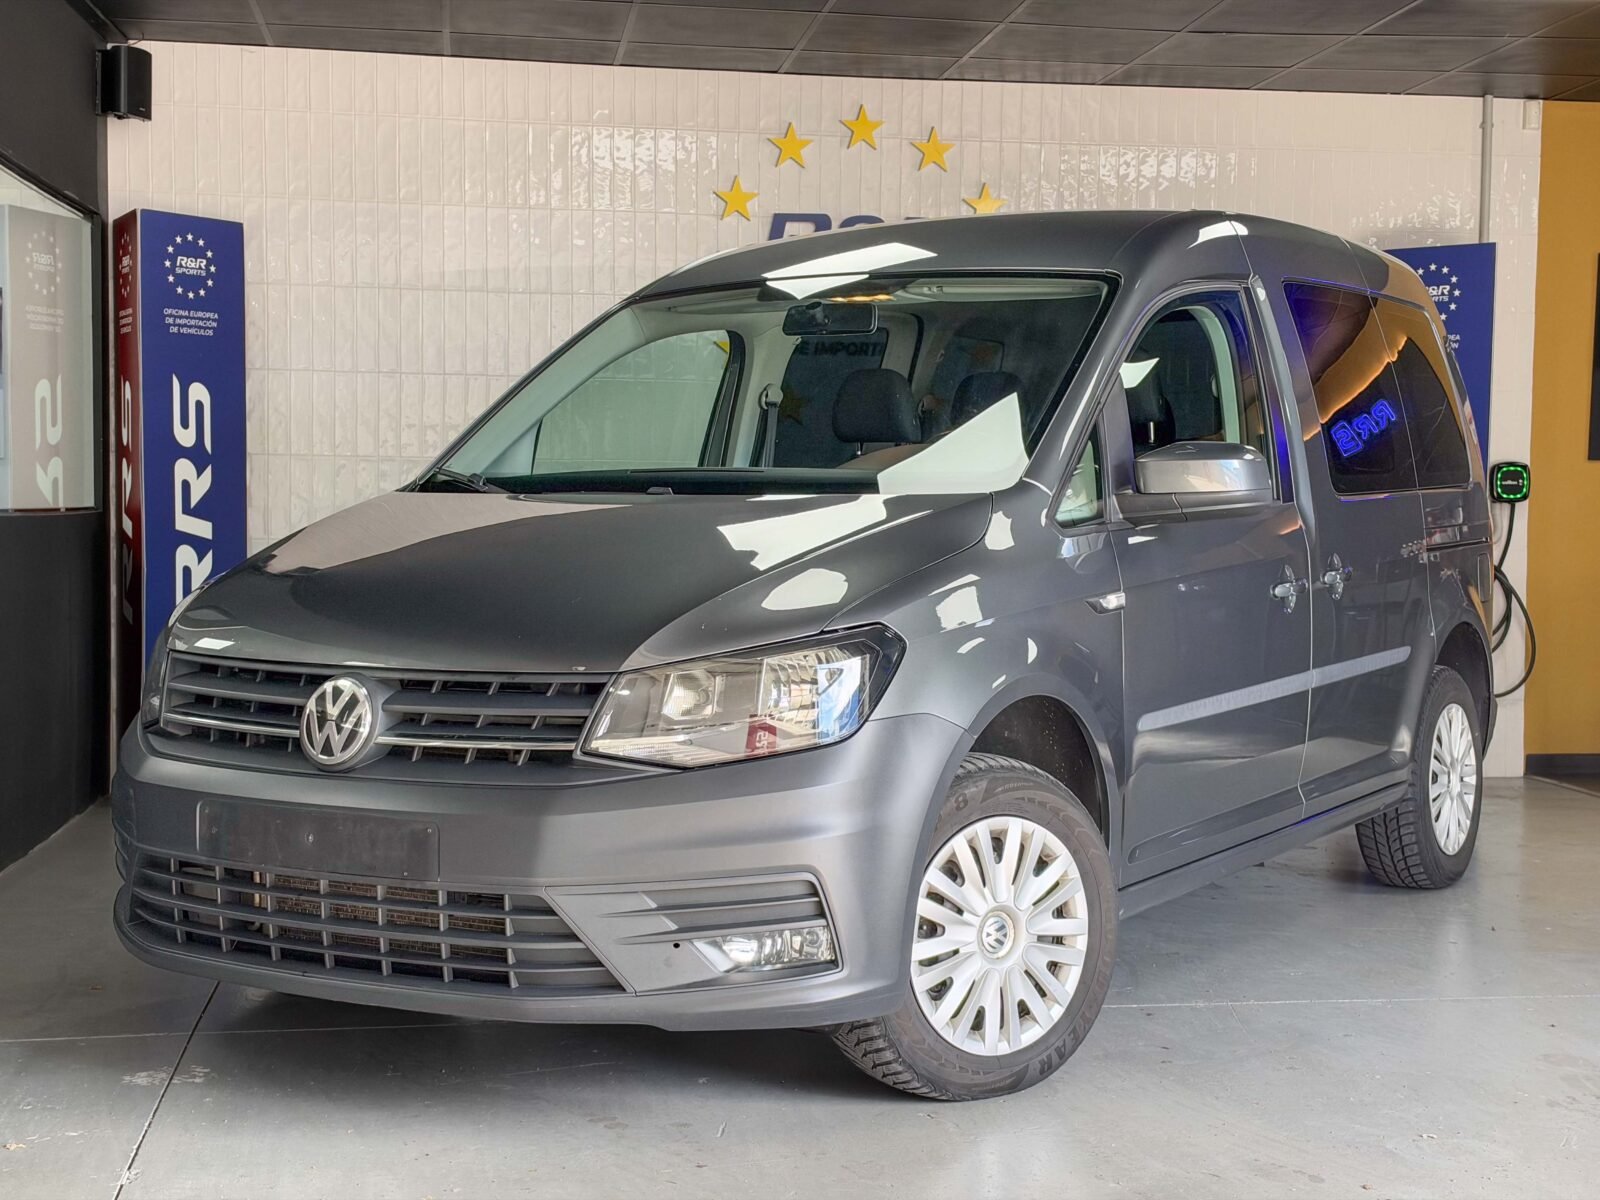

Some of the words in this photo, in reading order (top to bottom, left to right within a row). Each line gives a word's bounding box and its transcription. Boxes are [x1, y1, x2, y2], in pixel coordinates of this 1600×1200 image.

[176, 256, 207, 269] R&R
[175, 267, 207, 276] SPORTS
[1425, 285, 1451, 296] &R
[163, 308, 189, 317] OFICINA
[190, 311, 218, 319] EUROPEA
[175, 318, 217, 327] IMPORTACIÓN
[180, 327, 214, 336] VEHÍCULOS
[814, 341, 883, 356] IMPORT
[172, 373, 213, 606] RRS
